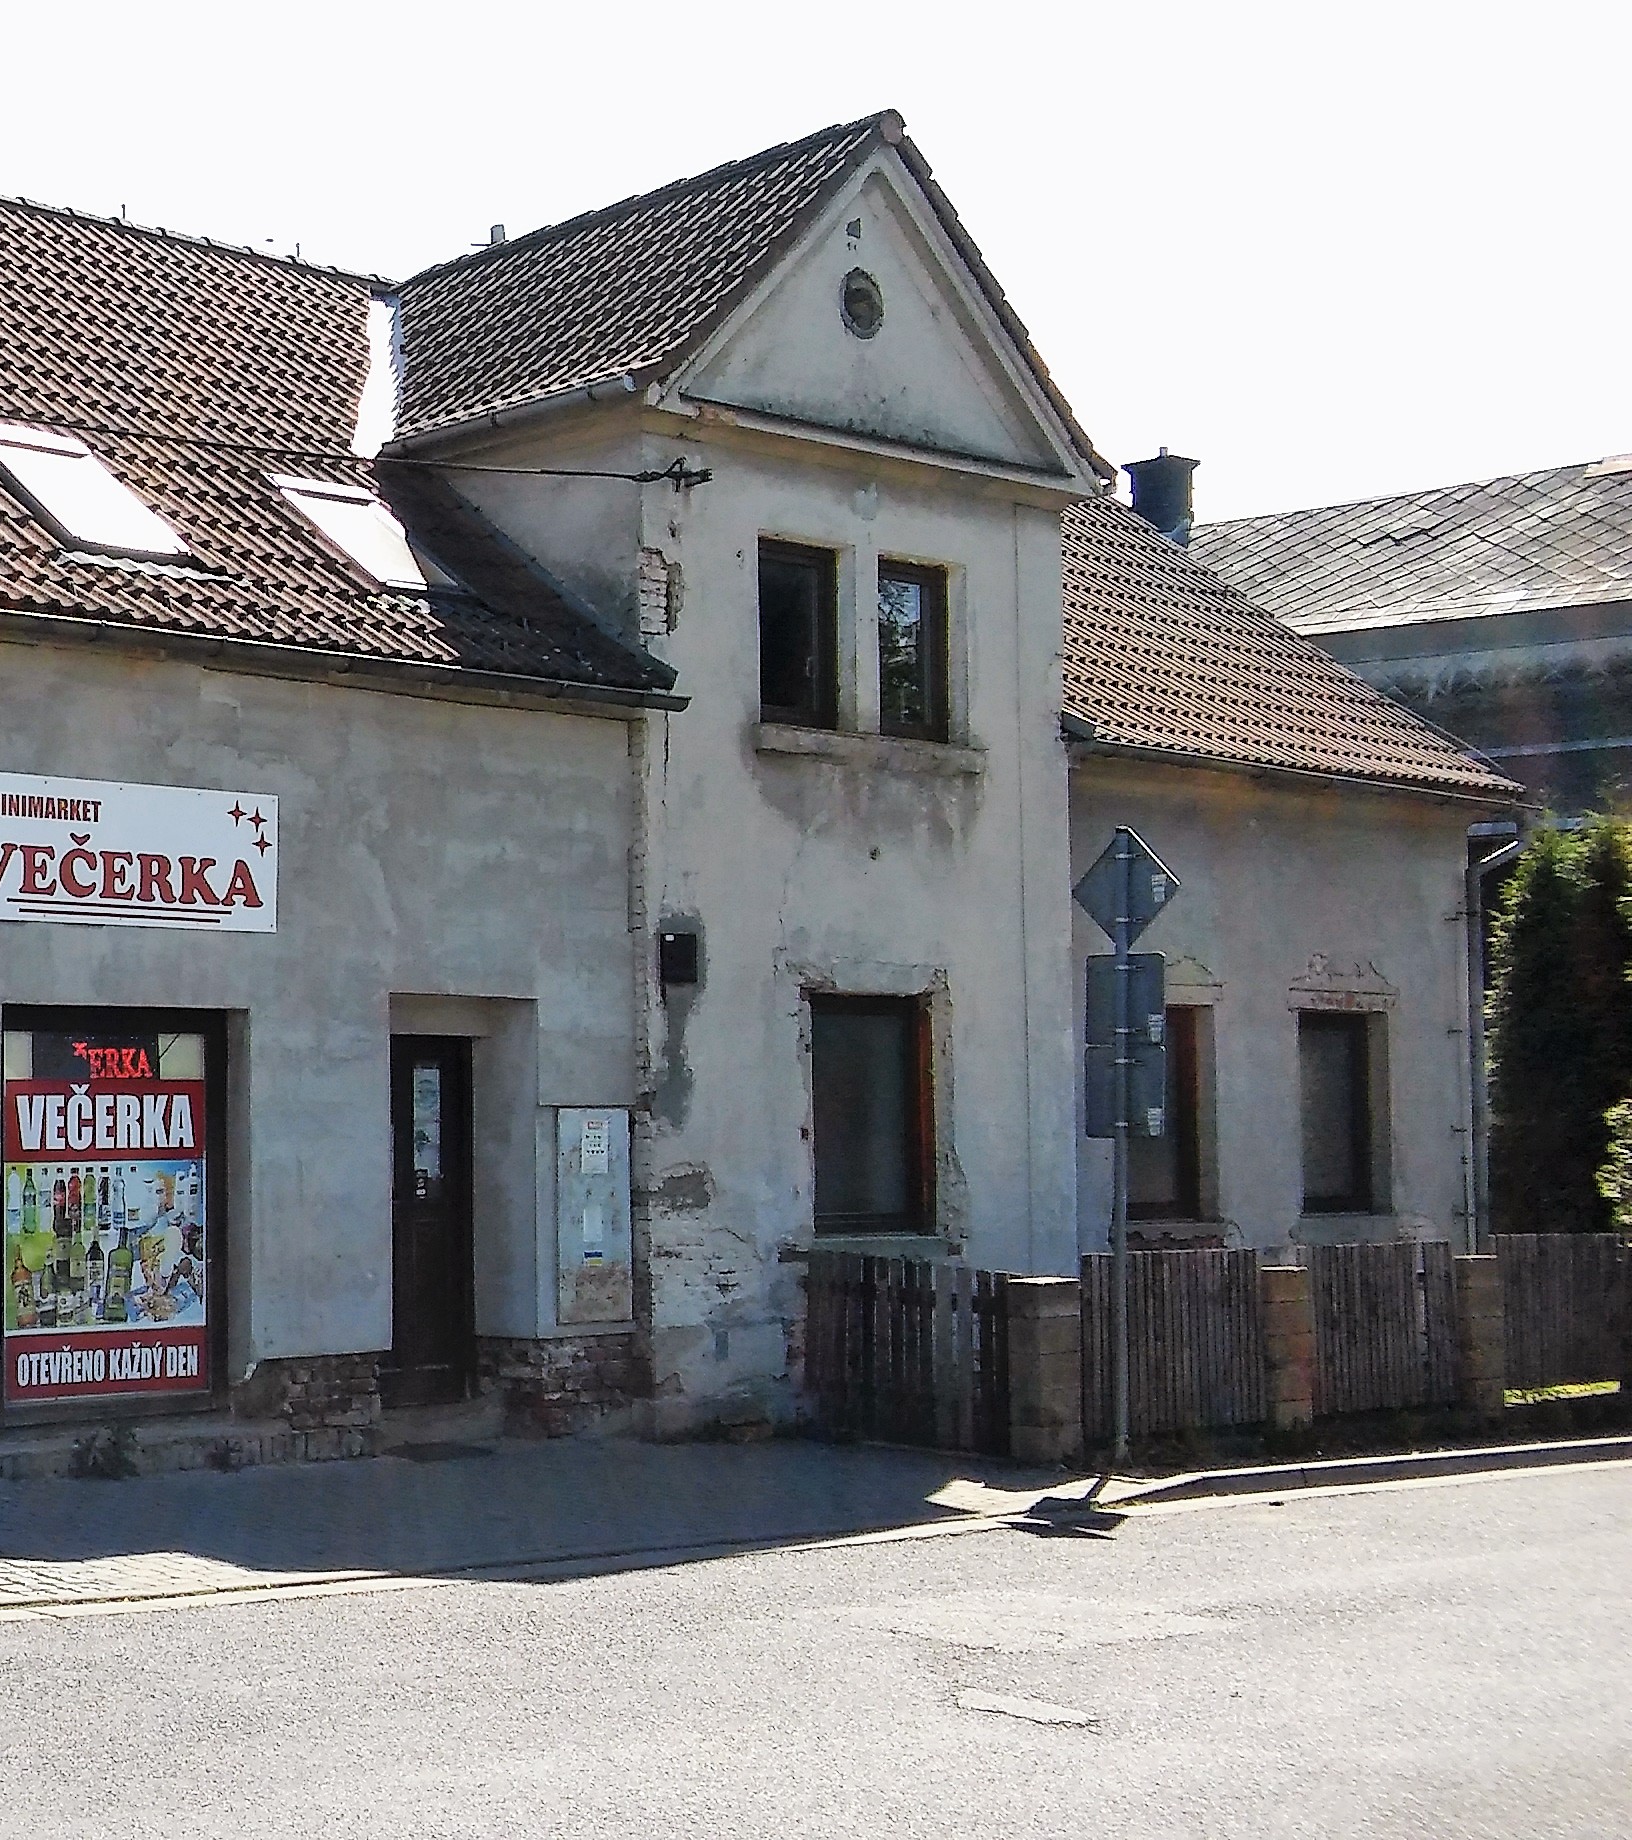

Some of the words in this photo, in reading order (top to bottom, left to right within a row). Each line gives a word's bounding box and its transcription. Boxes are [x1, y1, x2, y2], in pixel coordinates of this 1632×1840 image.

[16, 1083, 195, 1151] VEČERKA
[18, 1345, 106, 1387] OTEVŘENO
[109, 1341, 163, 1380] KAŽDÝ
[166, 1345, 199, 1378] DEN
